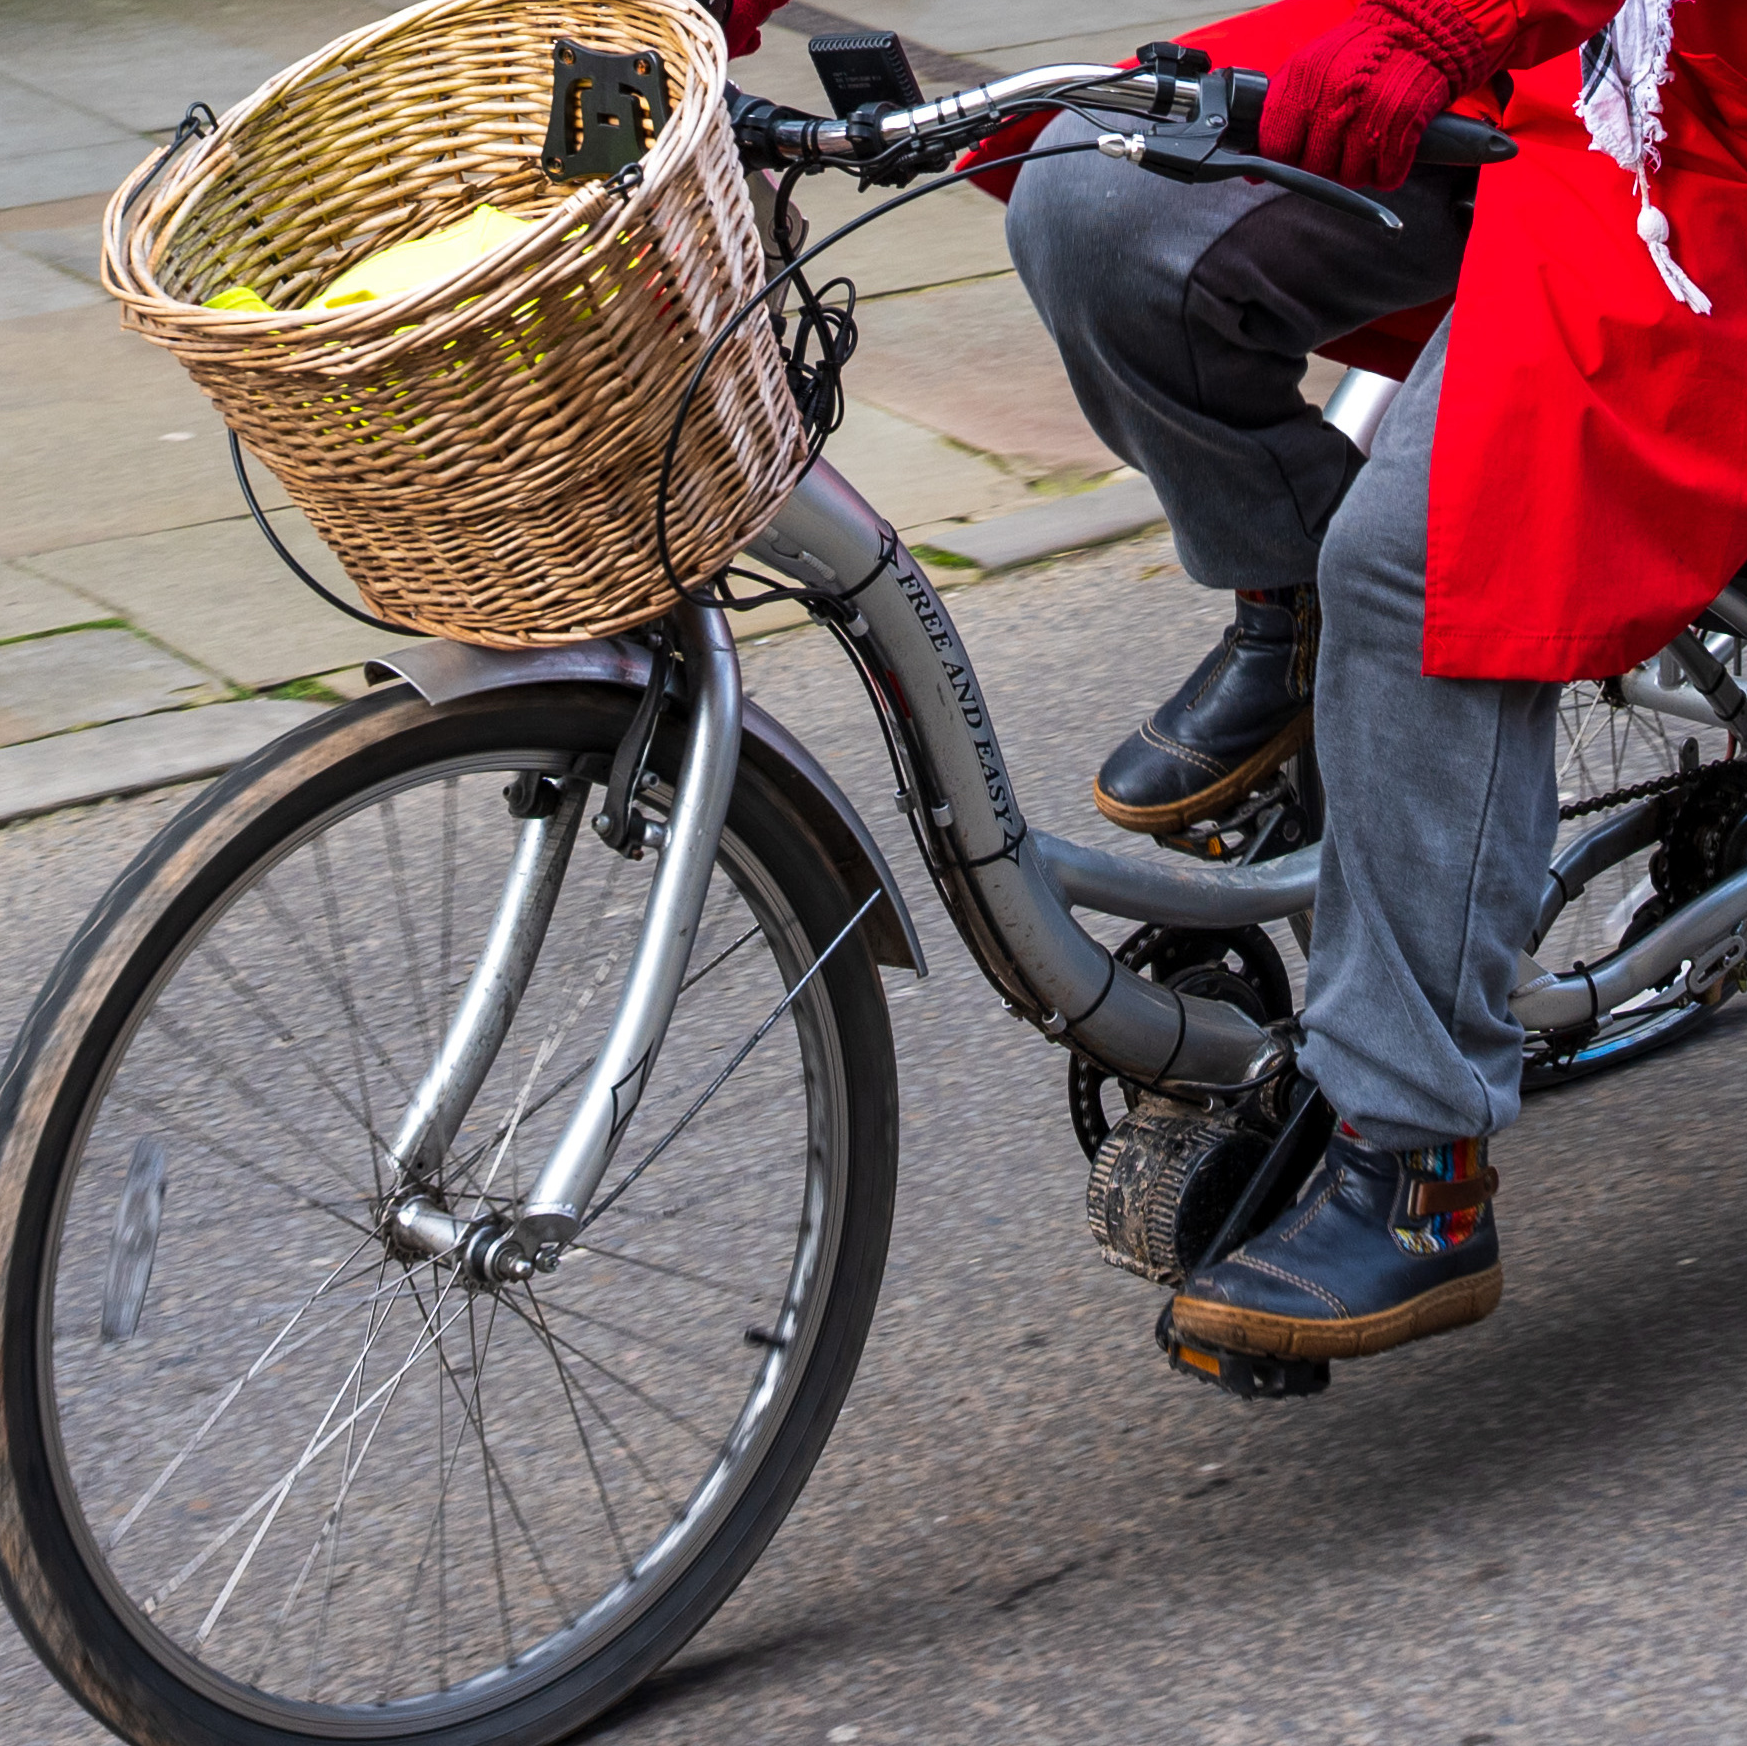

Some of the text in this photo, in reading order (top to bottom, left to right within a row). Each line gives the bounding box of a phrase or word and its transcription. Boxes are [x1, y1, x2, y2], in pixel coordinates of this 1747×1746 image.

[896, 570, 1014, 826] FREE AND EASY
